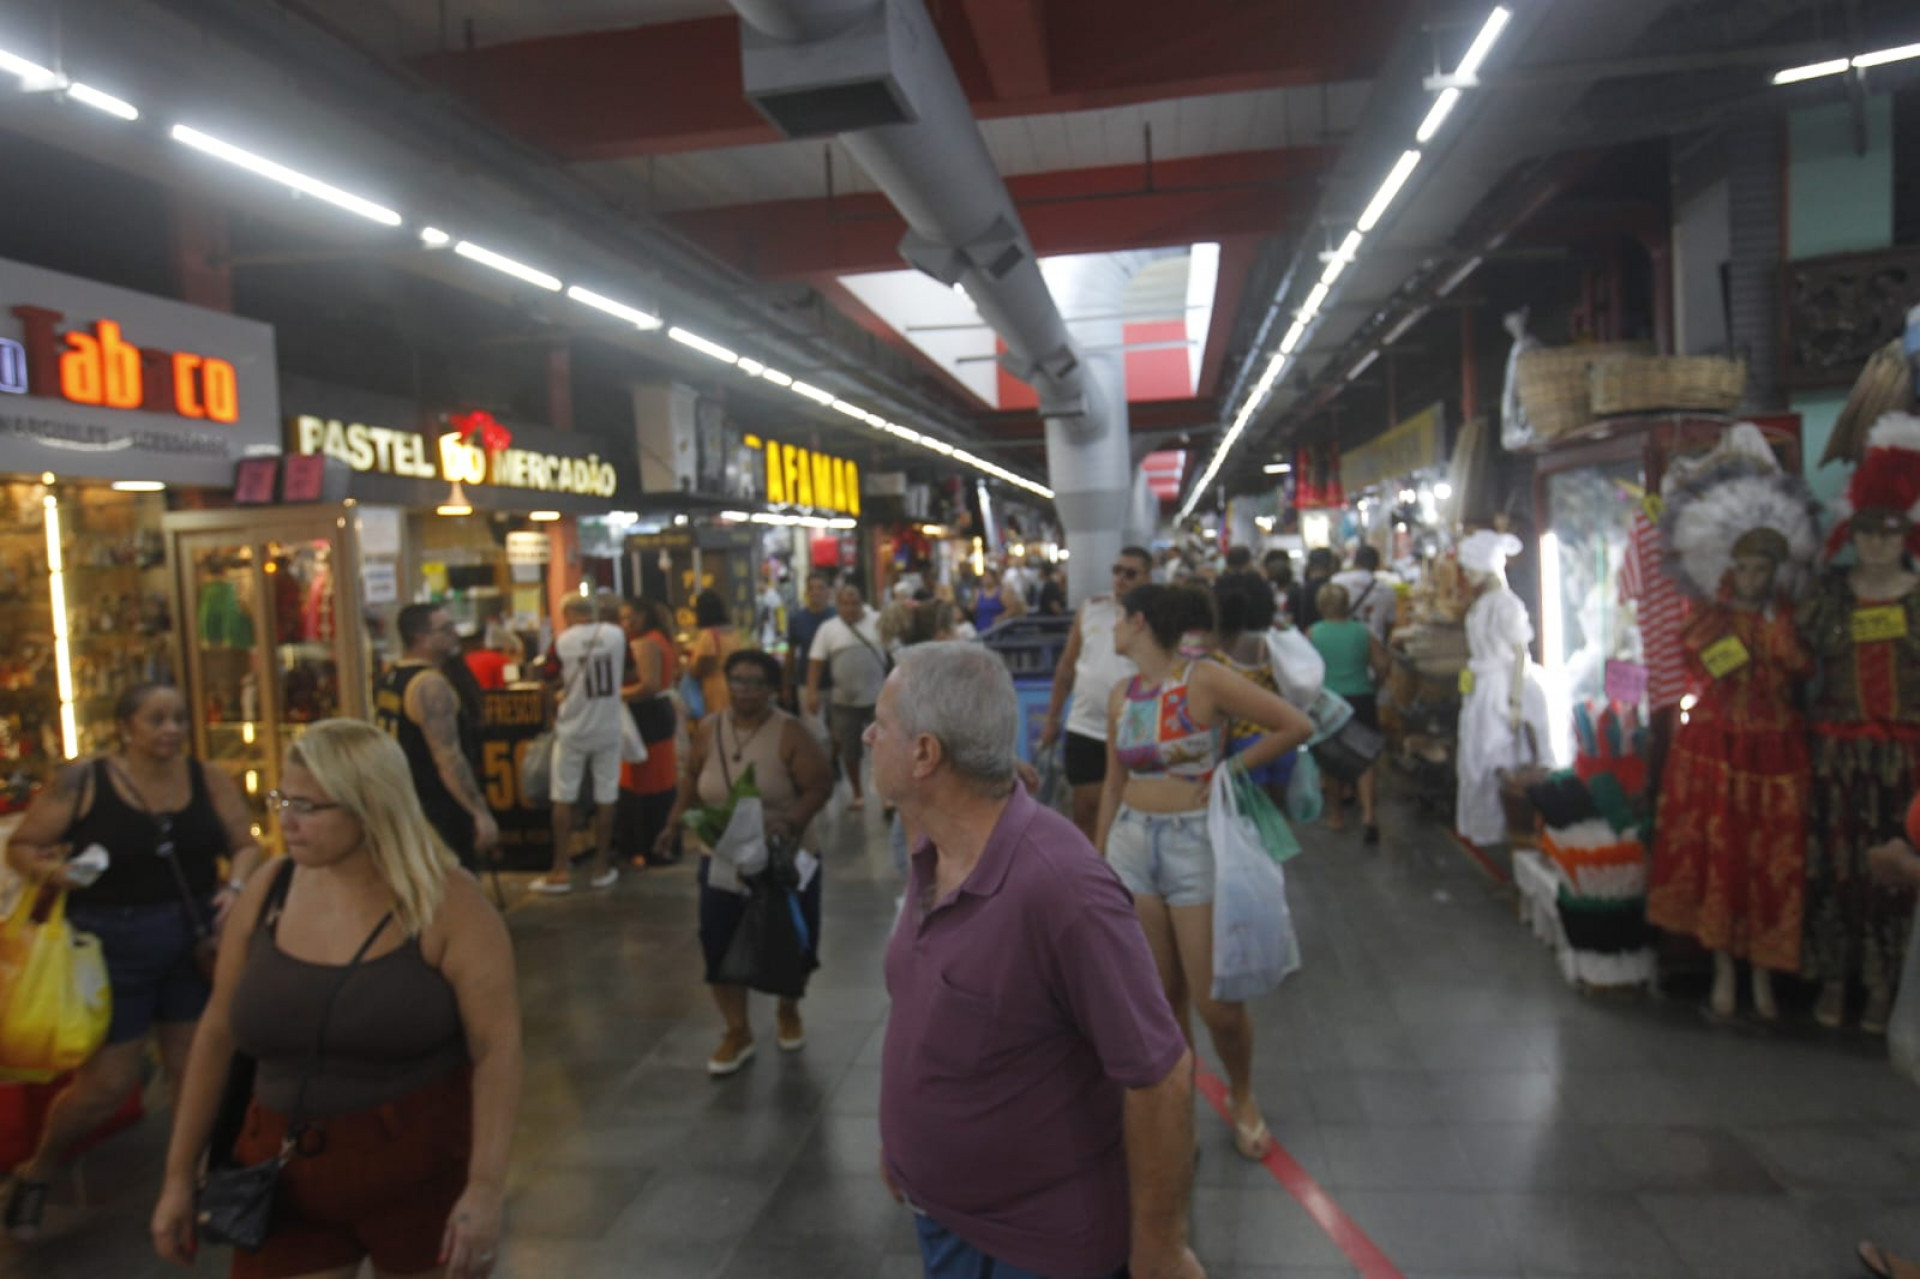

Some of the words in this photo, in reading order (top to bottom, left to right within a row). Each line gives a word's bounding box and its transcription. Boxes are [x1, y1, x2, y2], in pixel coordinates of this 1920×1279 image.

[10, 304, 239, 423] Tabaco
[299, 414, 436, 478] PASTEL
[493, 446, 616, 498] MERCADÃO
